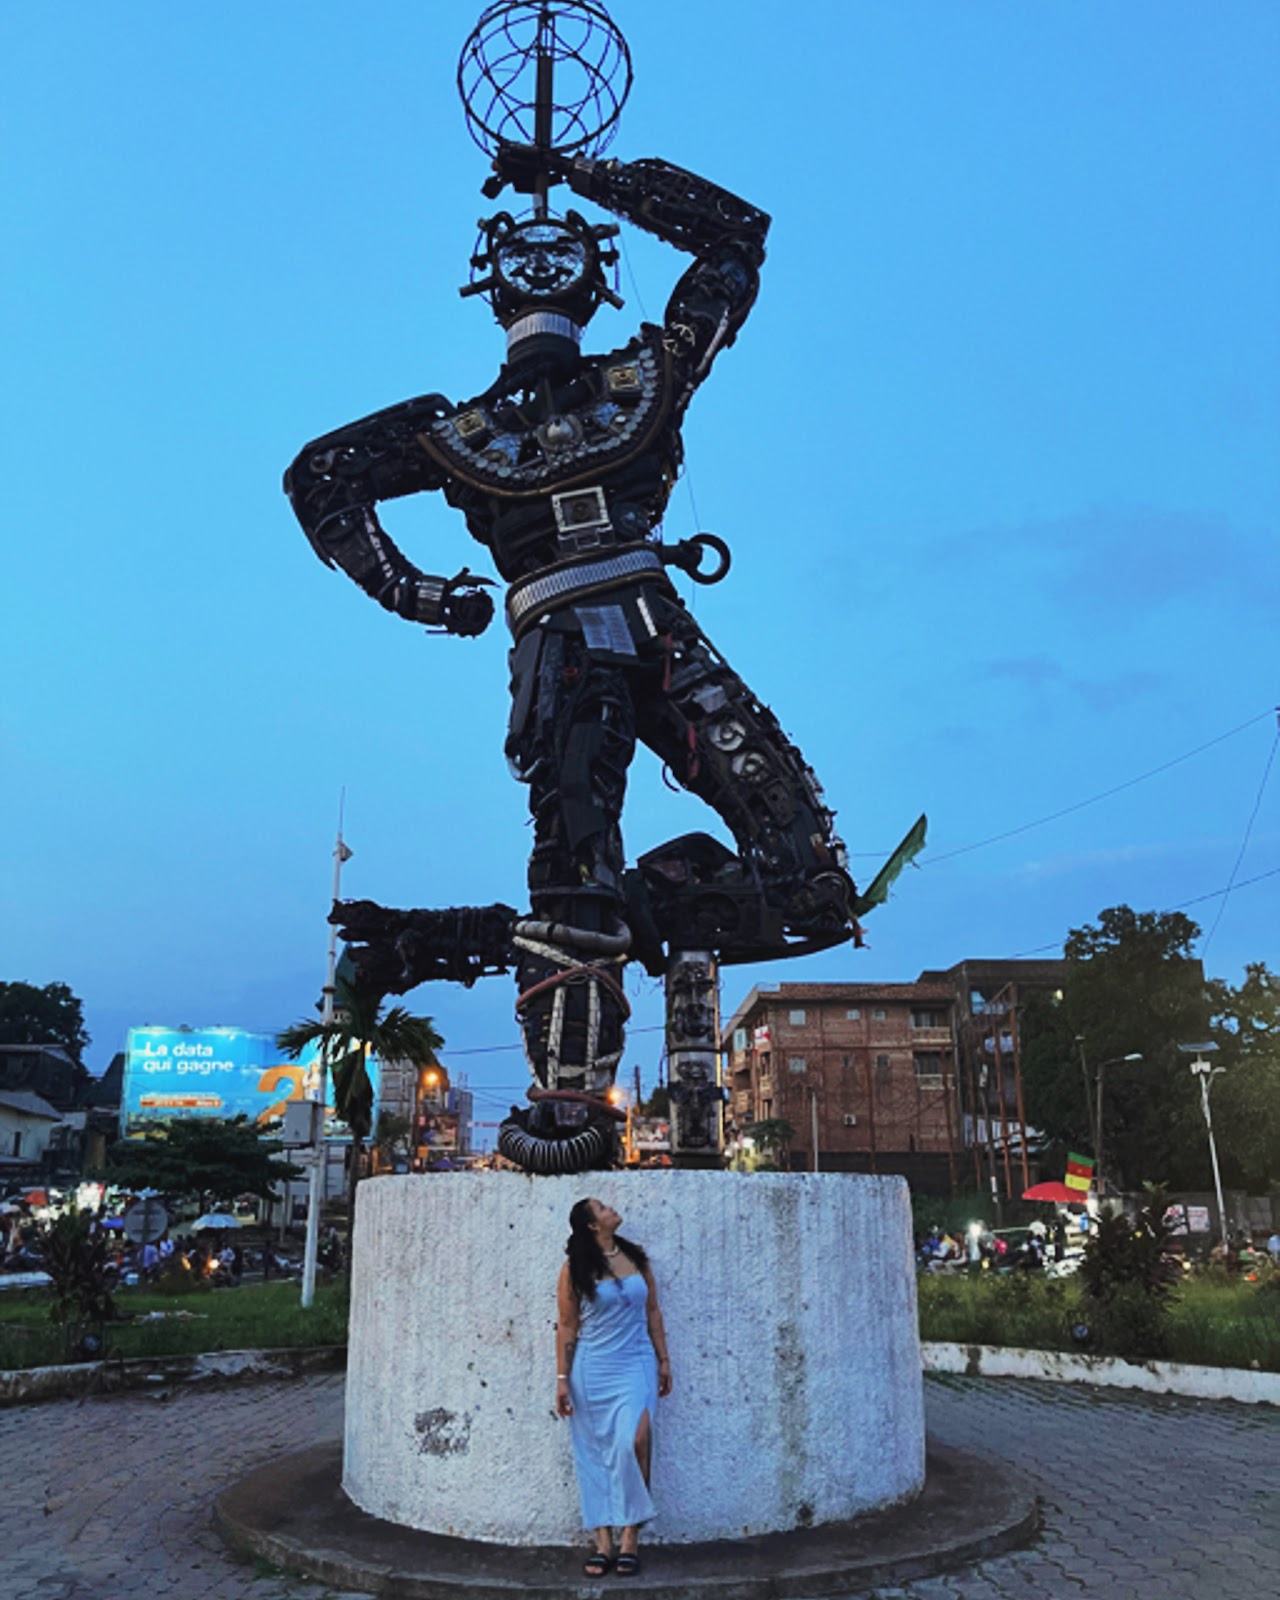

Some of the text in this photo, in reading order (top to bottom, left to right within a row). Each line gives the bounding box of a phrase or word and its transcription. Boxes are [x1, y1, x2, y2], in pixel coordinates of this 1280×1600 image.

[144, 1041, 213, 1057] La data
[143, 1057, 234, 1075] qui gagne
